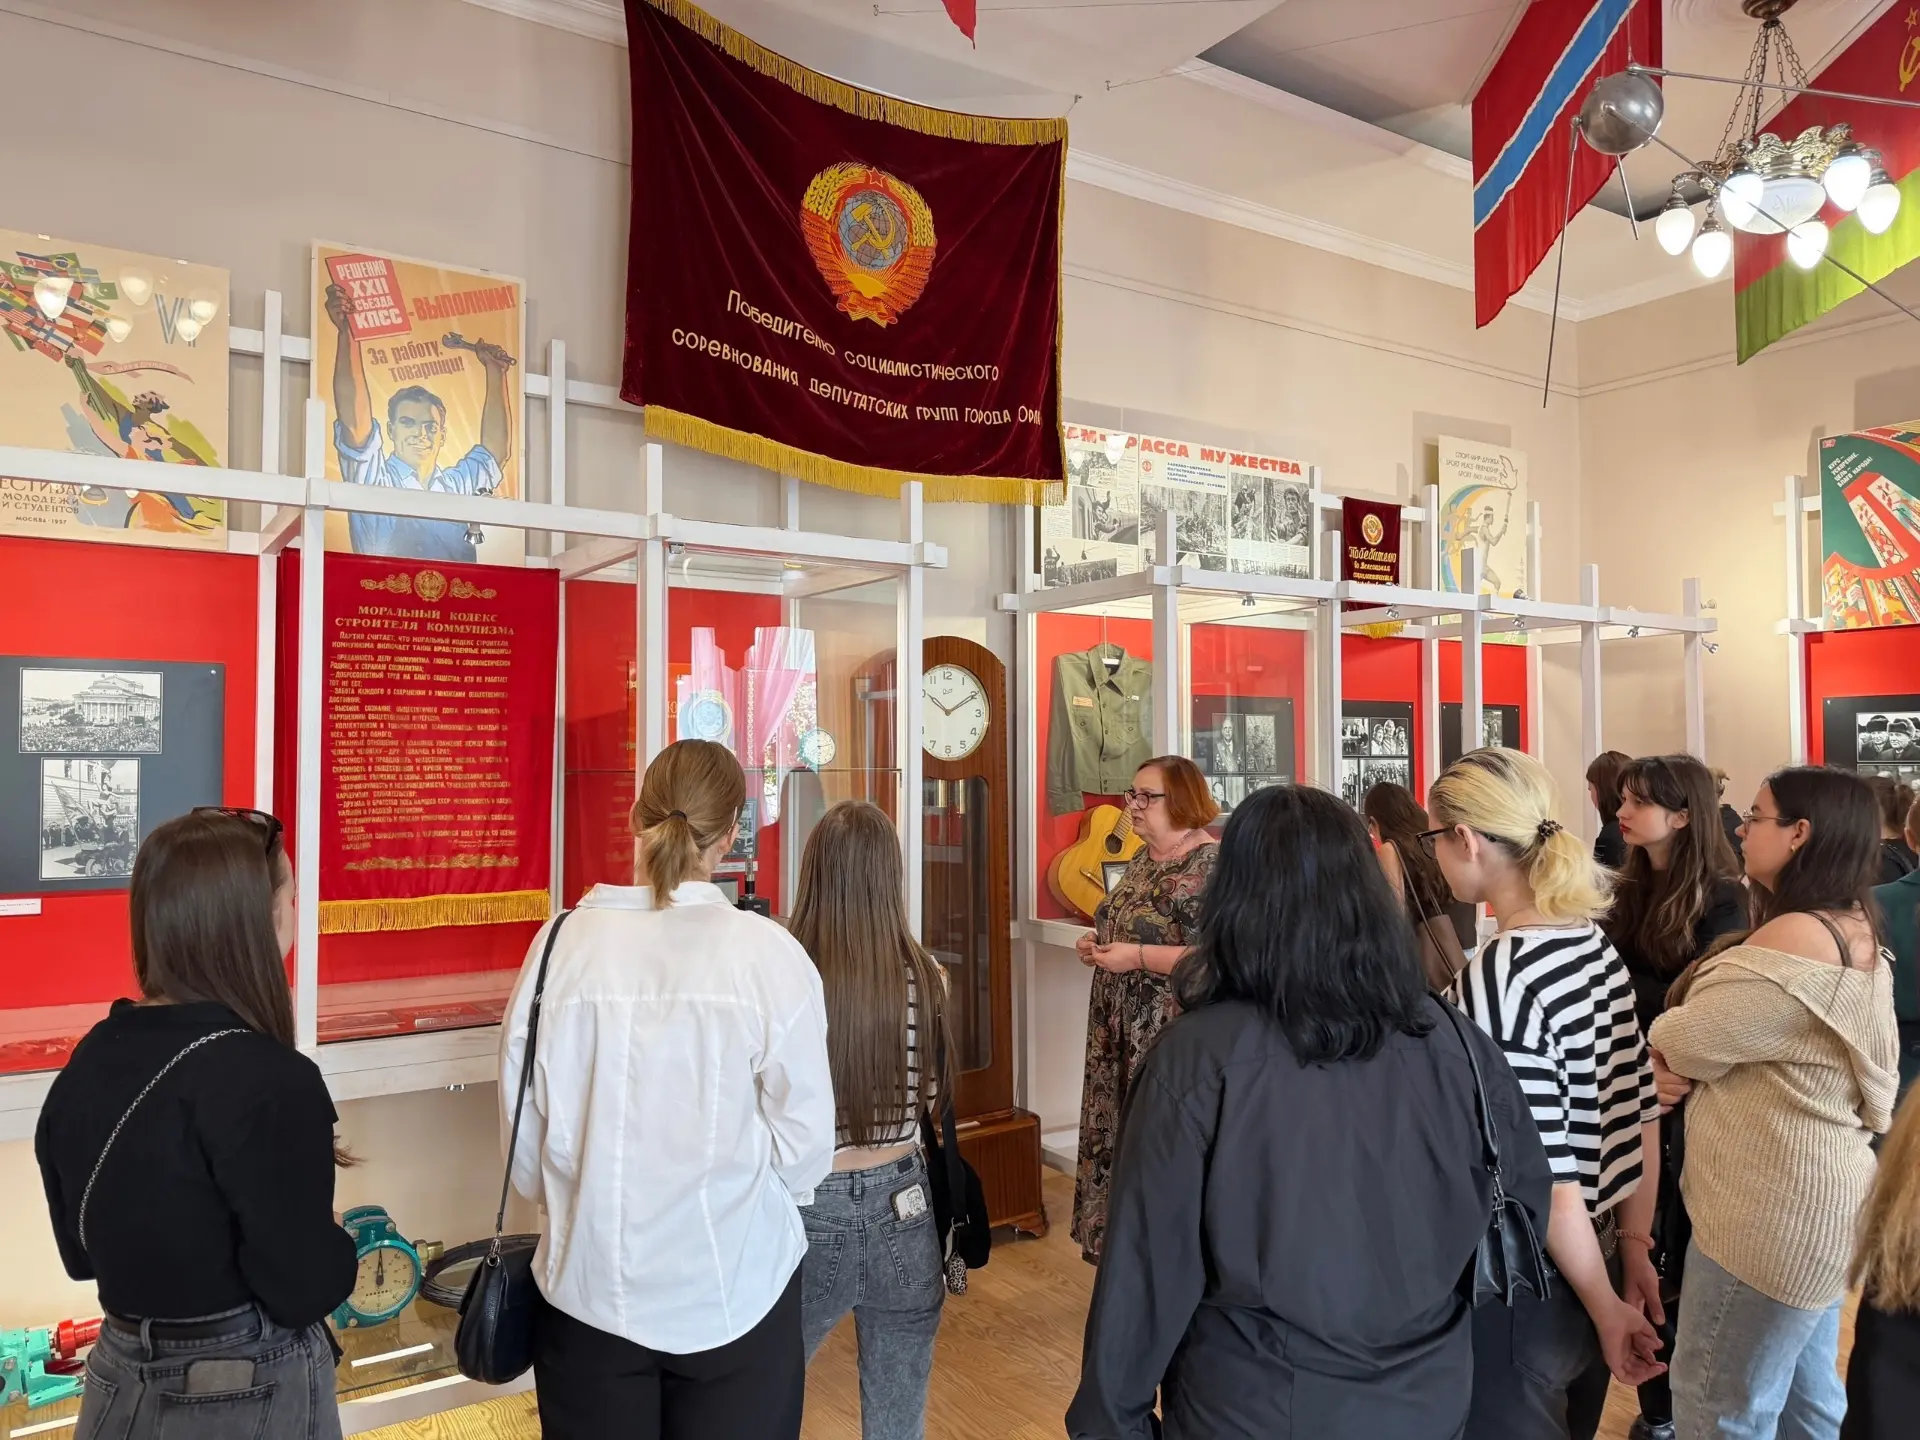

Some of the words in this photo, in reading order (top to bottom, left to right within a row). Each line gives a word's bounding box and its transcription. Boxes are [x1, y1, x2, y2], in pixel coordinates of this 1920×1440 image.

[336, 260, 387, 280] РЕШЕНИЯ
[348, 278, 390, 298] XXII
[354, 295, 394, 312] СЪЕЗДА
[354, 308, 403, 330] КПСС
[726, 289, 836, 356] Победителю
[368, 348, 388, 366] За
[388, 356, 465, 382] товарищи!
[845, 350, 1000, 382] социалистического
[672, 328, 799, 386] соревнования
[808, 377, 908, 420] депутатских
[916, 406, 958, 422] групп
[964, 407, 1012, 426] города
[14, 502, 80, 514] СТУДЕНТОВ
[358, 606, 440, 619] МОРАЛЬНЫЙ
[450, 612, 498, 622] КОДЕКС
[335, 618, 418, 630] СТРОИТЕЛЯ
[426, 622, 514, 635] КОММУНИЗМА
[930, 676, 936, 684] 11
[943, 671, 952, 680] 12
[975, 709, 981, 718] 3
[970, 728, 977, 736] 4
[930, 740, 936, 749] 7
[945, 746, 951, 754] 6
[960, 740, 966, 749] 5
